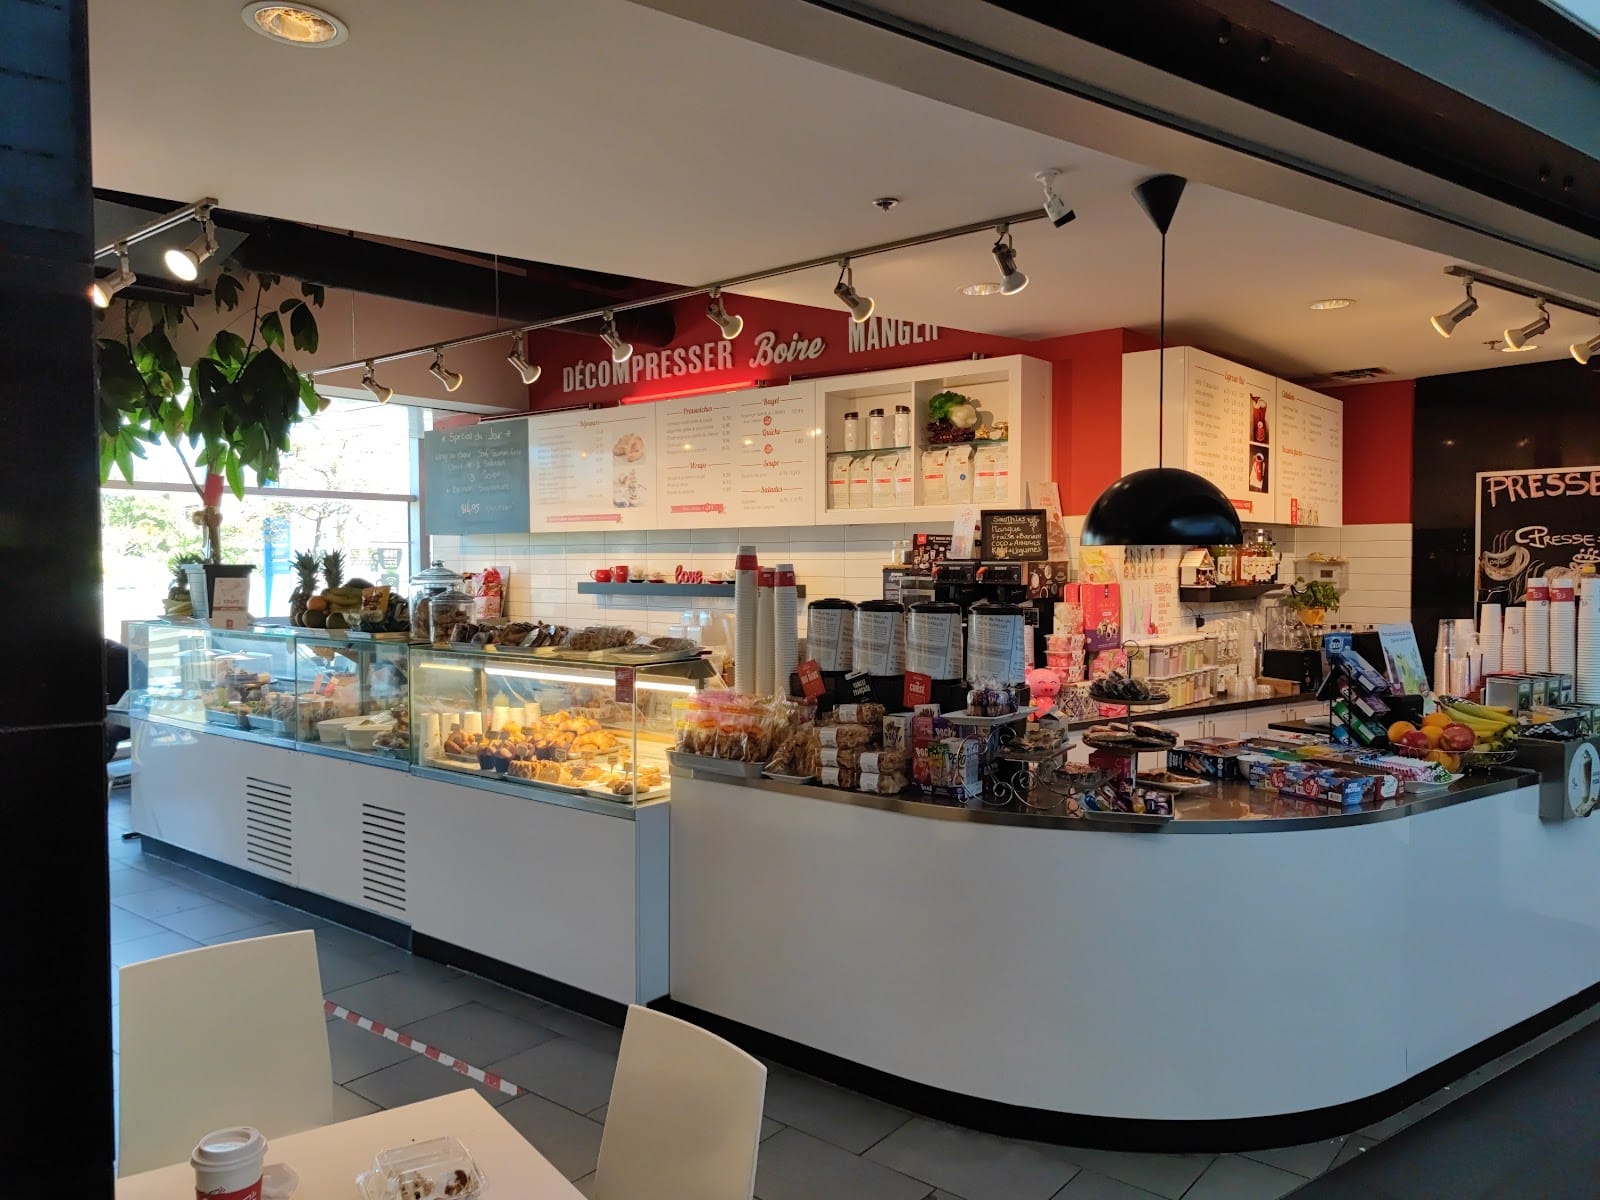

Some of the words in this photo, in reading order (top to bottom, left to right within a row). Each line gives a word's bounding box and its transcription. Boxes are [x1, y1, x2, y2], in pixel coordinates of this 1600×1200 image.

[563, 340, 733, 393] DÉCOMPRESSER
[748, 331, 826, 369] Boire
[675, 565, 703, 584] love
